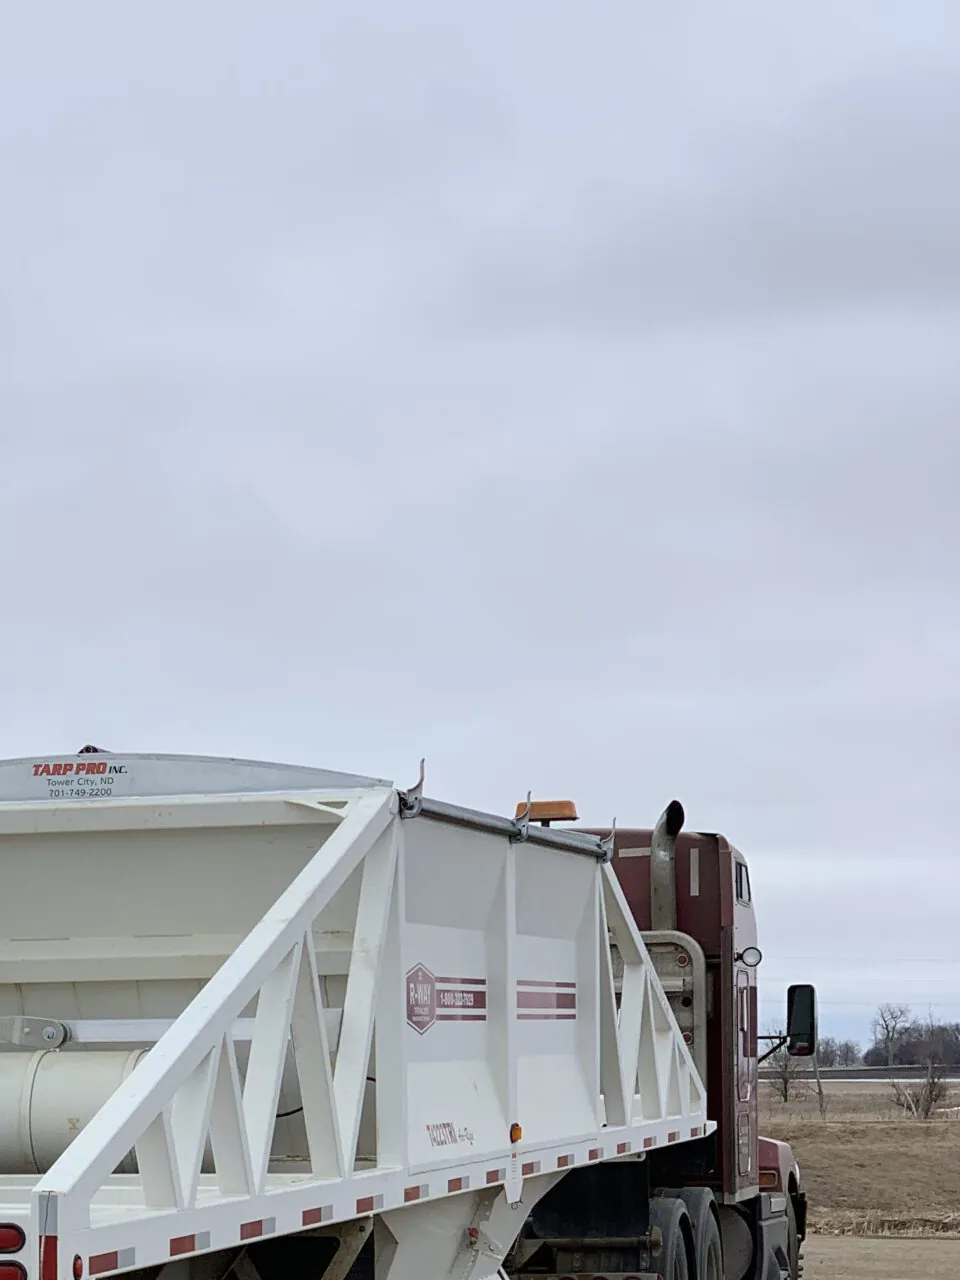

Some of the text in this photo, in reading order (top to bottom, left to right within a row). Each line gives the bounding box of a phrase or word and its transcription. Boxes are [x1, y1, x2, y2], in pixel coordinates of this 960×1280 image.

[33, 762, 128, 776] TARP PRO INC.
[46, 777, 114, 787] Tower City, ND
[49, 788, 112, 797] 701-749-2200
[409, 983, 432, 1005] R-WAY
